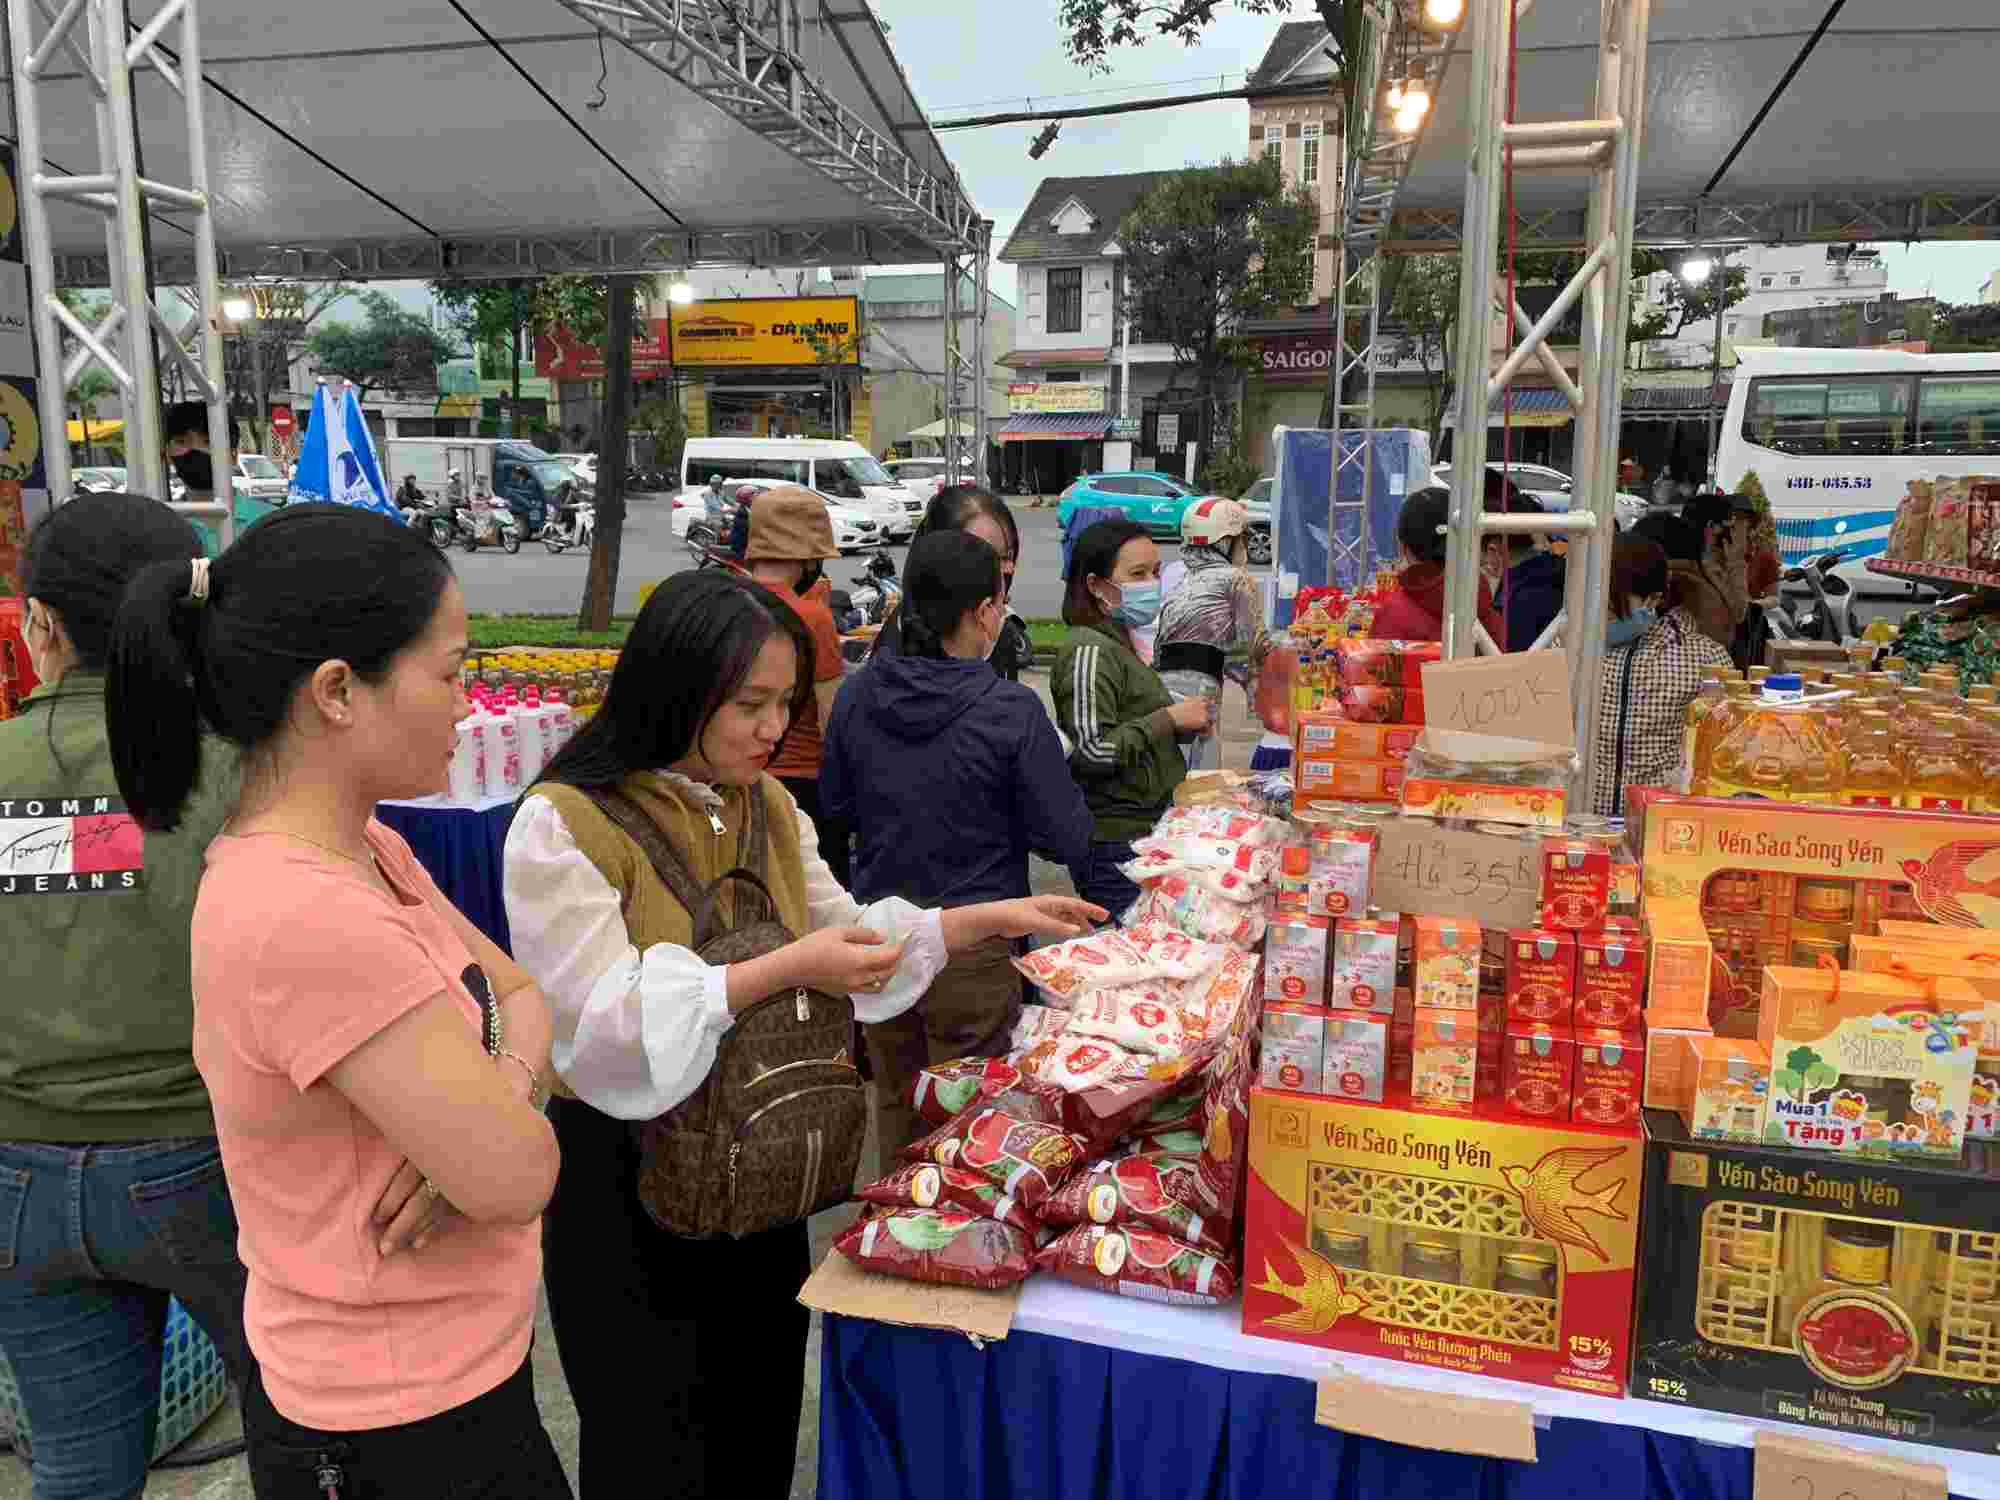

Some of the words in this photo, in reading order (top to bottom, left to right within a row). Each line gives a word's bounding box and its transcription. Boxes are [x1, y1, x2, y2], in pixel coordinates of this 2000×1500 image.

[1263, 350, 1332, 369] SAIGO
[0, 797, 108, 817] TOMM
[1795, 833, 1843, 868] Song
[3, 871, 135, 892] JEANS
[1776, 1099, 1814, 1116] Mua
[1818, 1103, 1827, 1116] 1
[1785, 1120, 1844, 1145] Tặng
[1323, 1121, 1358, 1149] Yến
[1362, 1126, 1398, 1156] Sào
[1402, 1132, 1450, 1170] Song
[1455, 1138, 1491, 1169] Yến
[1718, 1159, 1755, 1192] Yến
[1760, 1165, 1799, 1196] Sào
[1803, 1170, 1855, 1209] Song
[1859, 1175, 1900, 1208] Yến
[1568, 1335, 1613, 1354] 15%
[1648, 1377, 1688, 1396] 15%
